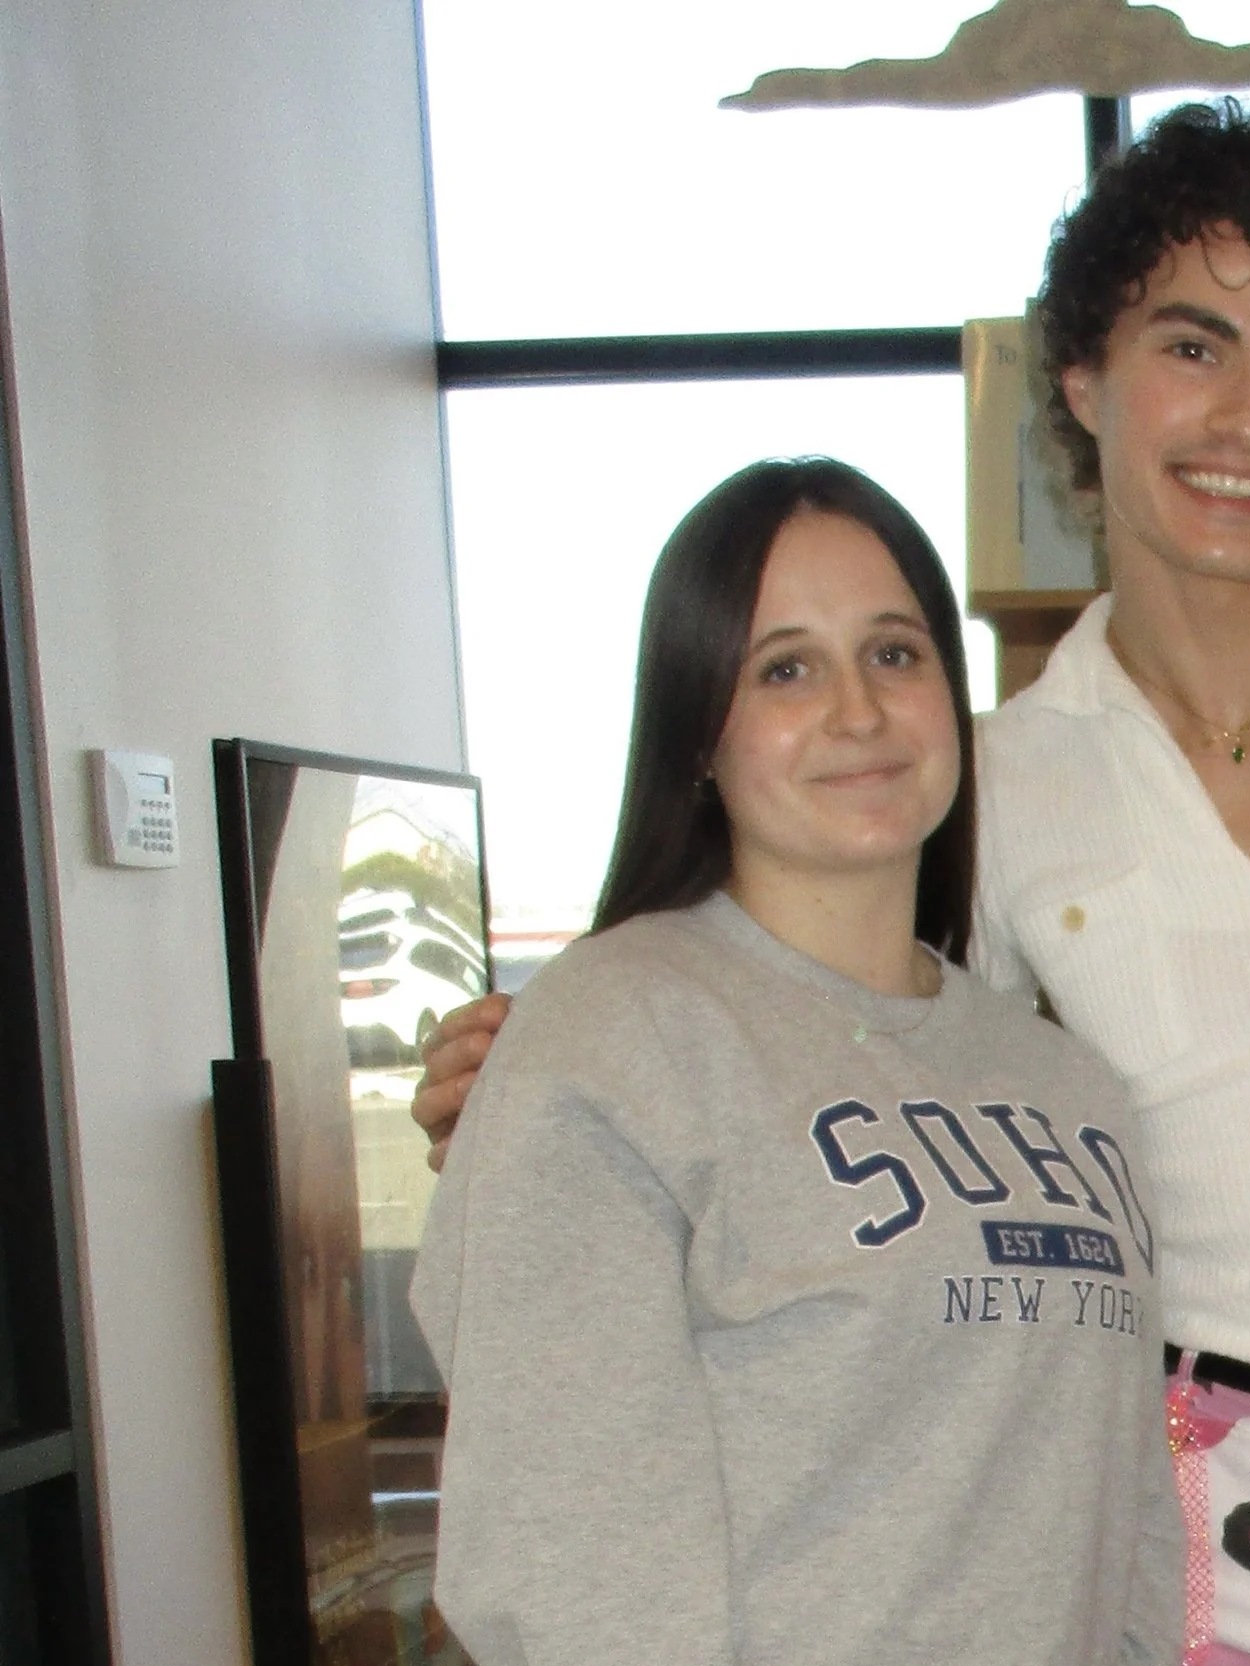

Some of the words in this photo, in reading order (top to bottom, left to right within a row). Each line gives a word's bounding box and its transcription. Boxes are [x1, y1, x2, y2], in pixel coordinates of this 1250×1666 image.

[809, 1097, 1154, 1277] SOHO
[996, 1228, 1056, 1260] EST.
[1067, 1231, 1117, 1266] 1624
[943, 1276, 1047, 1324] NEW
